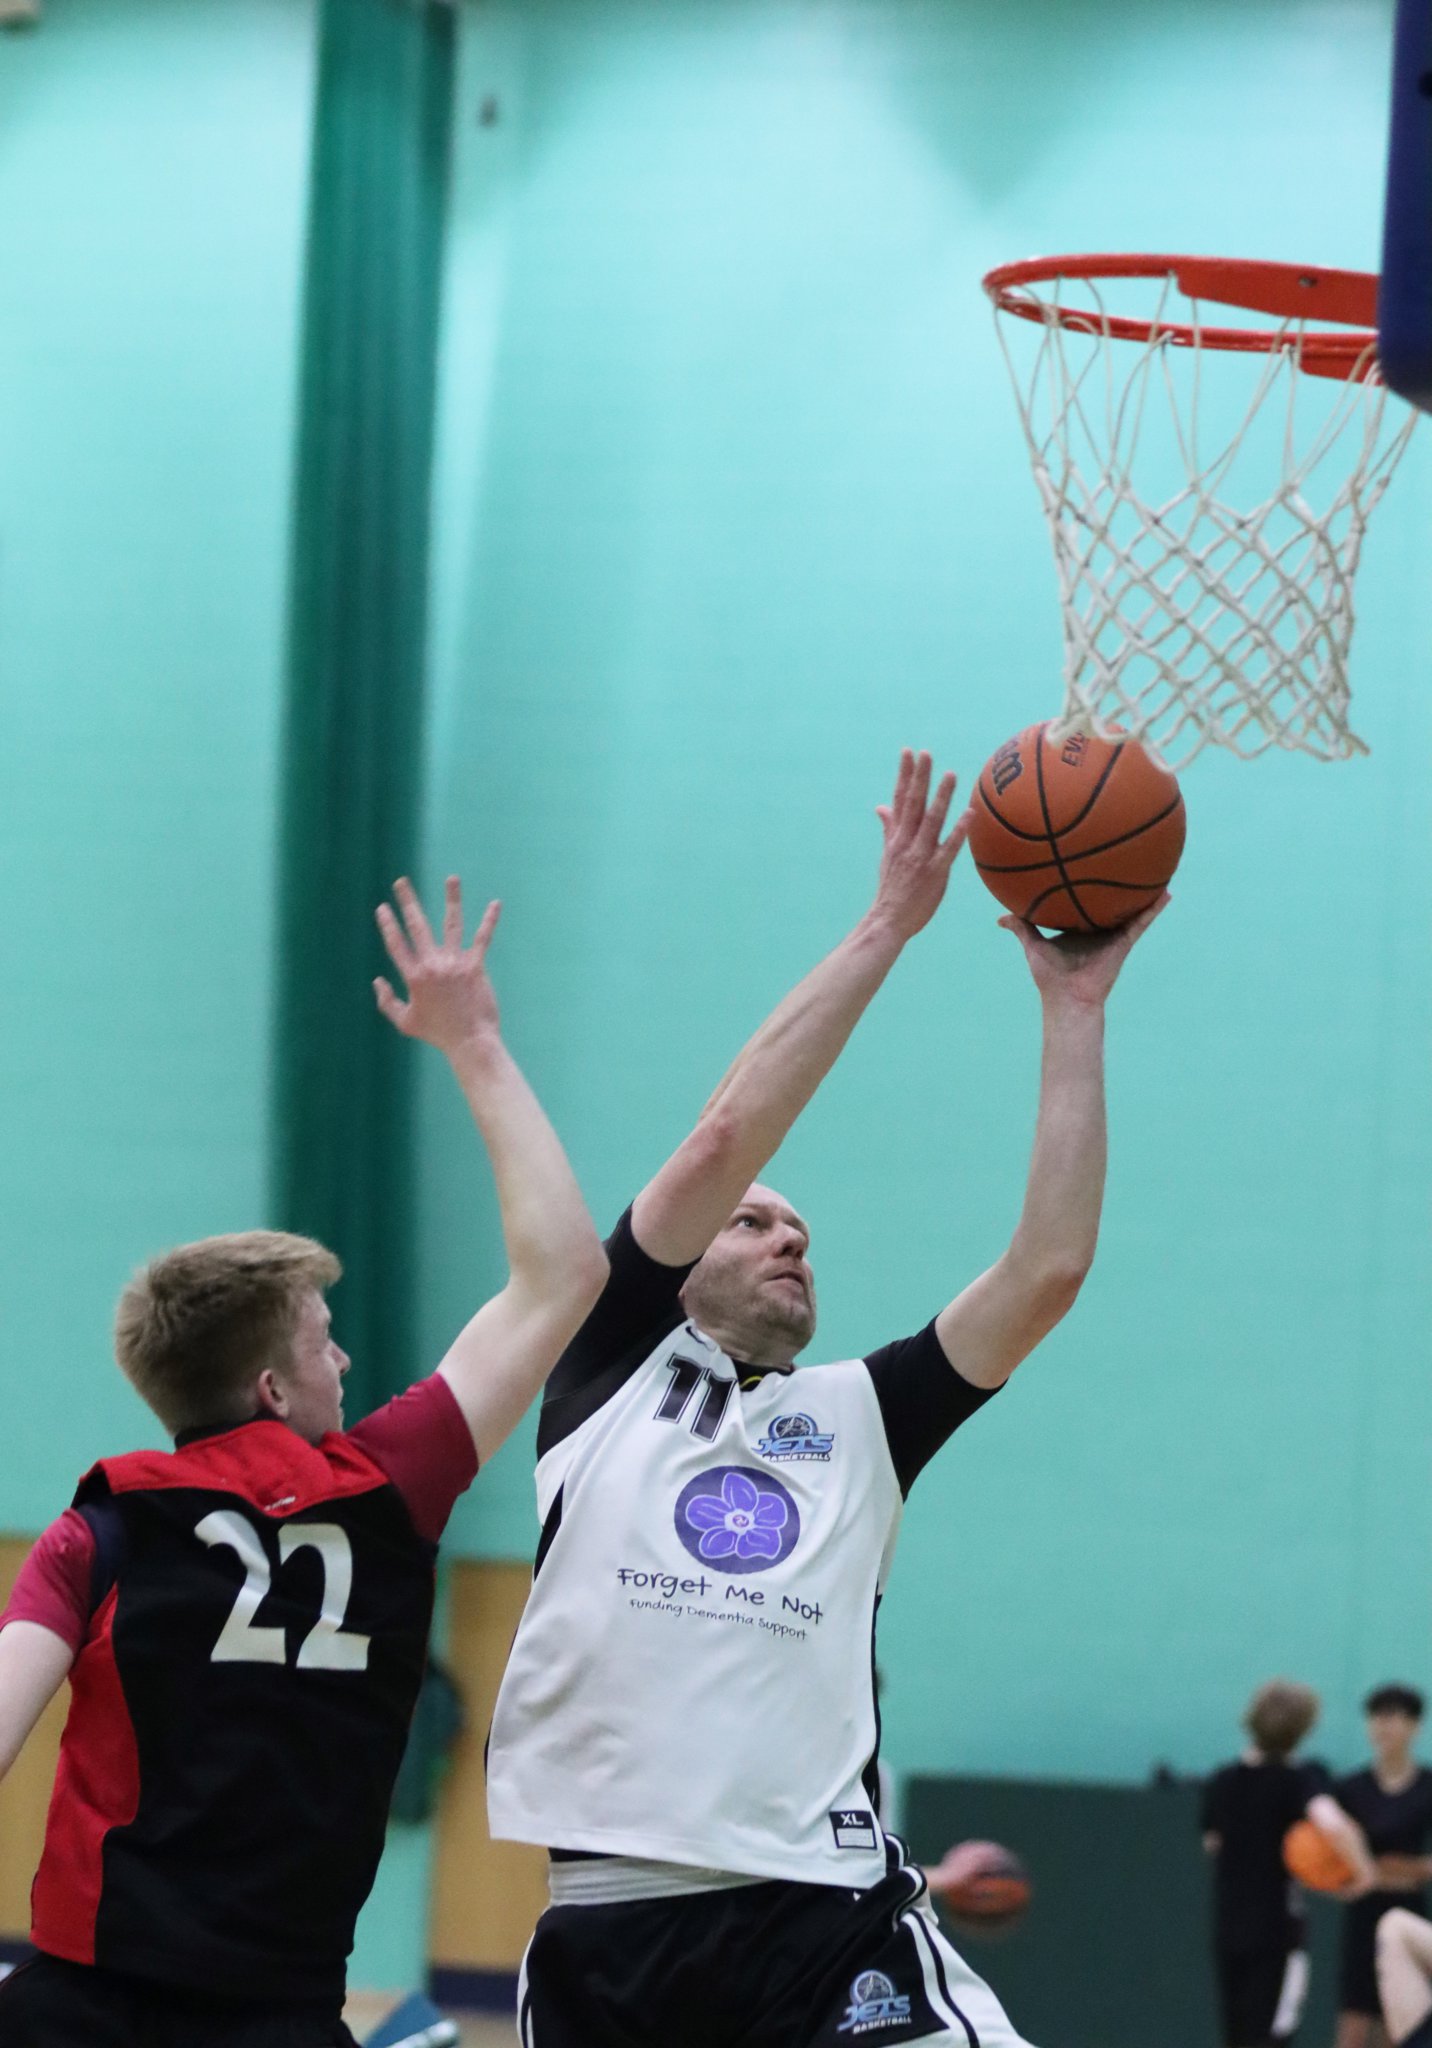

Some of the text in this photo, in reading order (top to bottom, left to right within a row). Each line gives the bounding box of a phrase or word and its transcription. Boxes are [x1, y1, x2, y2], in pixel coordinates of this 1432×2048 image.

[653, 1352, 738, 1443] 11
[752, 1432, 834, 1455] JETS
[194, 1509, 371, 1671] 22
[617, 1568, 823, 1625] Forget Me Not
[629, 1598, 807, 1640] Funding Dementia Support
[840, 1813, 864, 1826] XL
[836, 1995, 911, 2031] JETS
